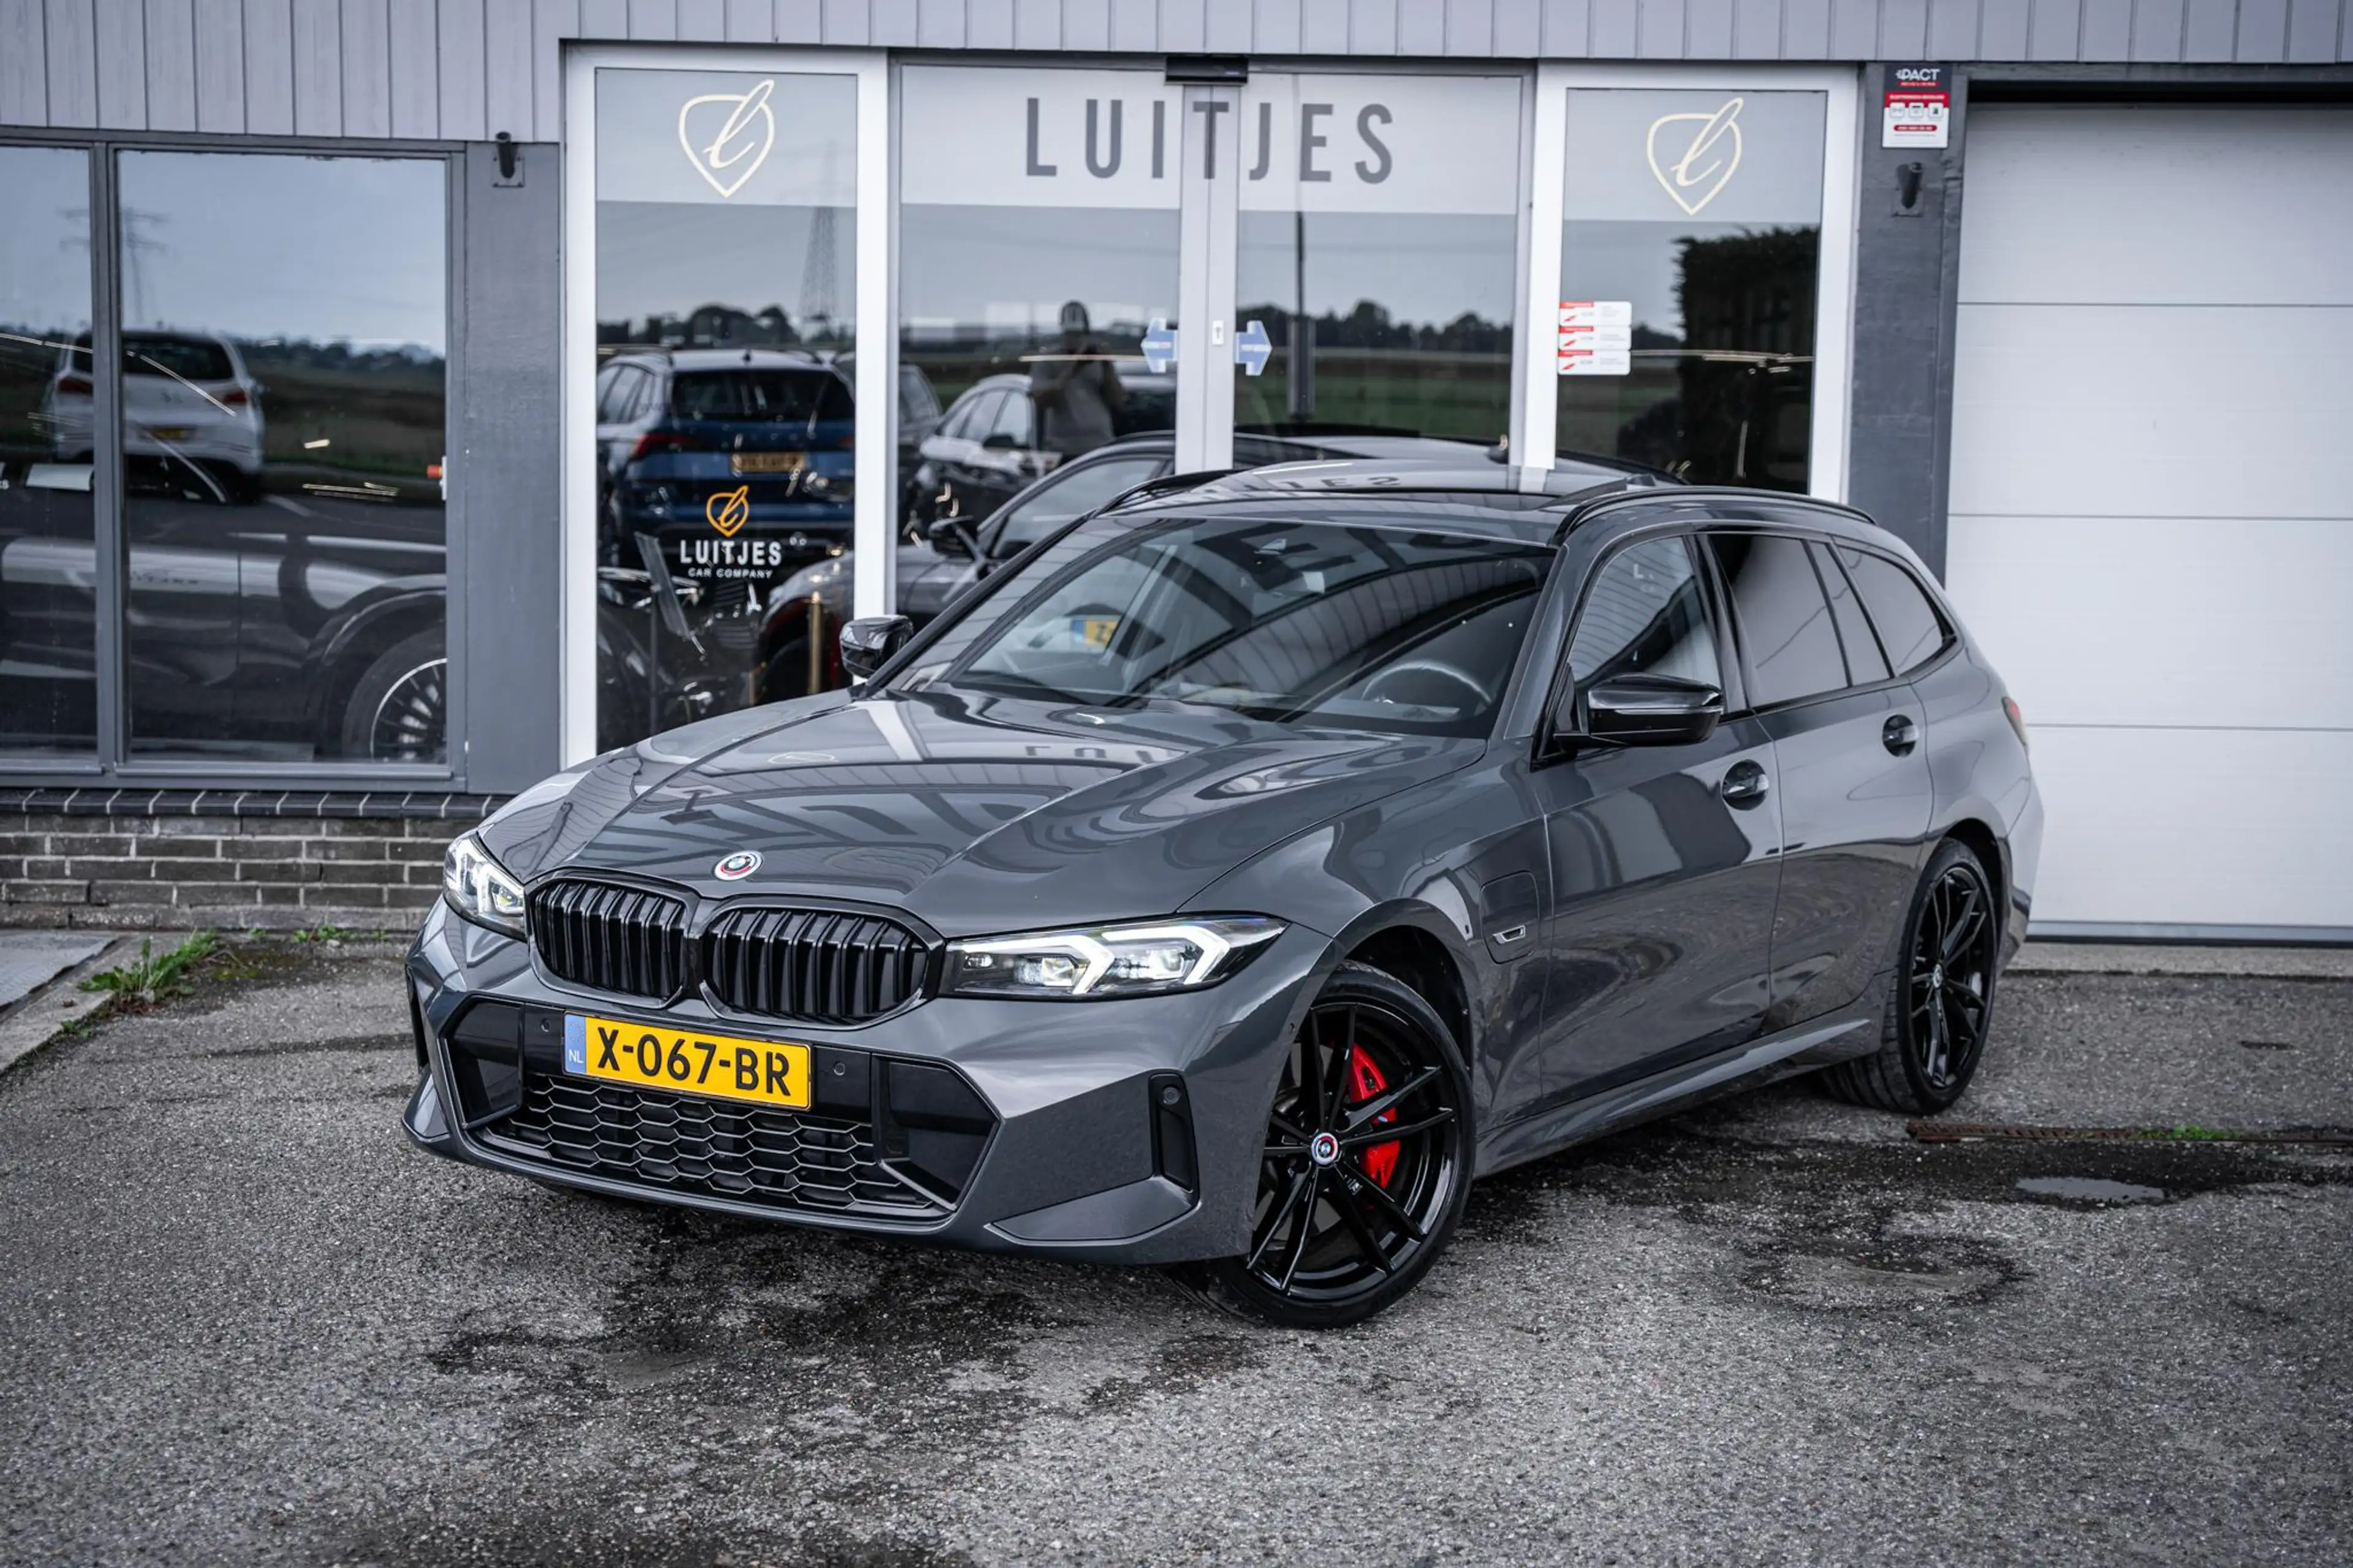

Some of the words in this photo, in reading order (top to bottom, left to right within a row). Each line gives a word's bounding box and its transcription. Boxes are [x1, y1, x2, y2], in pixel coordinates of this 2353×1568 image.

[1026, 97, 1393, 184] LUITJES
[680, 539, 782, 566] LUITJES
[688, 567, 711, 577] CAR
[716, 568, 773, 579] COMPANY
[569, 1049, 583, 1064] NL
[597, 1026, 791, 1097] X-067-BR
